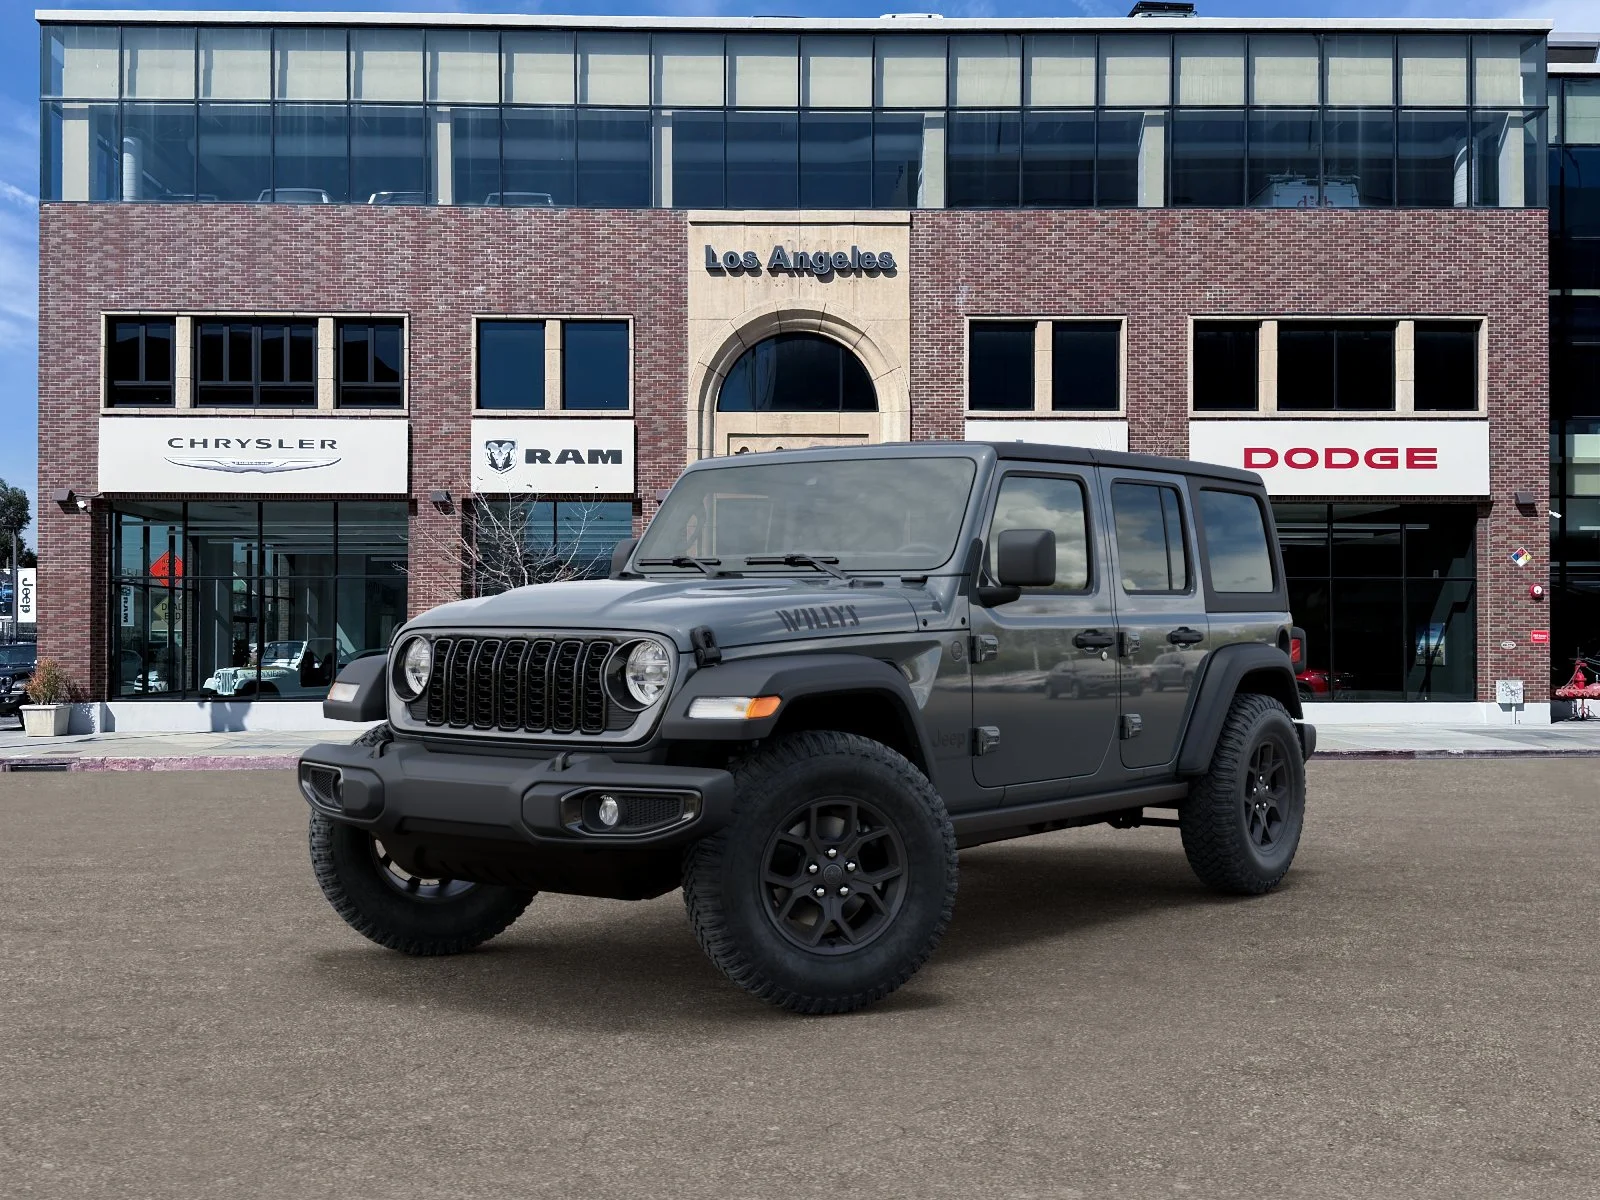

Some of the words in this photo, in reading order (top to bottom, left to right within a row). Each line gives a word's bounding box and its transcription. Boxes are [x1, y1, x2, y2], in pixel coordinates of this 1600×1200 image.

[705, 244, 758, 268] Los
[767, 245, 894, 275] Angeles
[167, 437, 337, 449] CHRYSLER
[525, 448, 622, 464] RAM
[1244, 447, 1437, 469] DODGE
[21, 577, 33, 613] Jeep
[775, 605, 859, 631] WILLYS
[932, 728, 966, 748] Jeep
